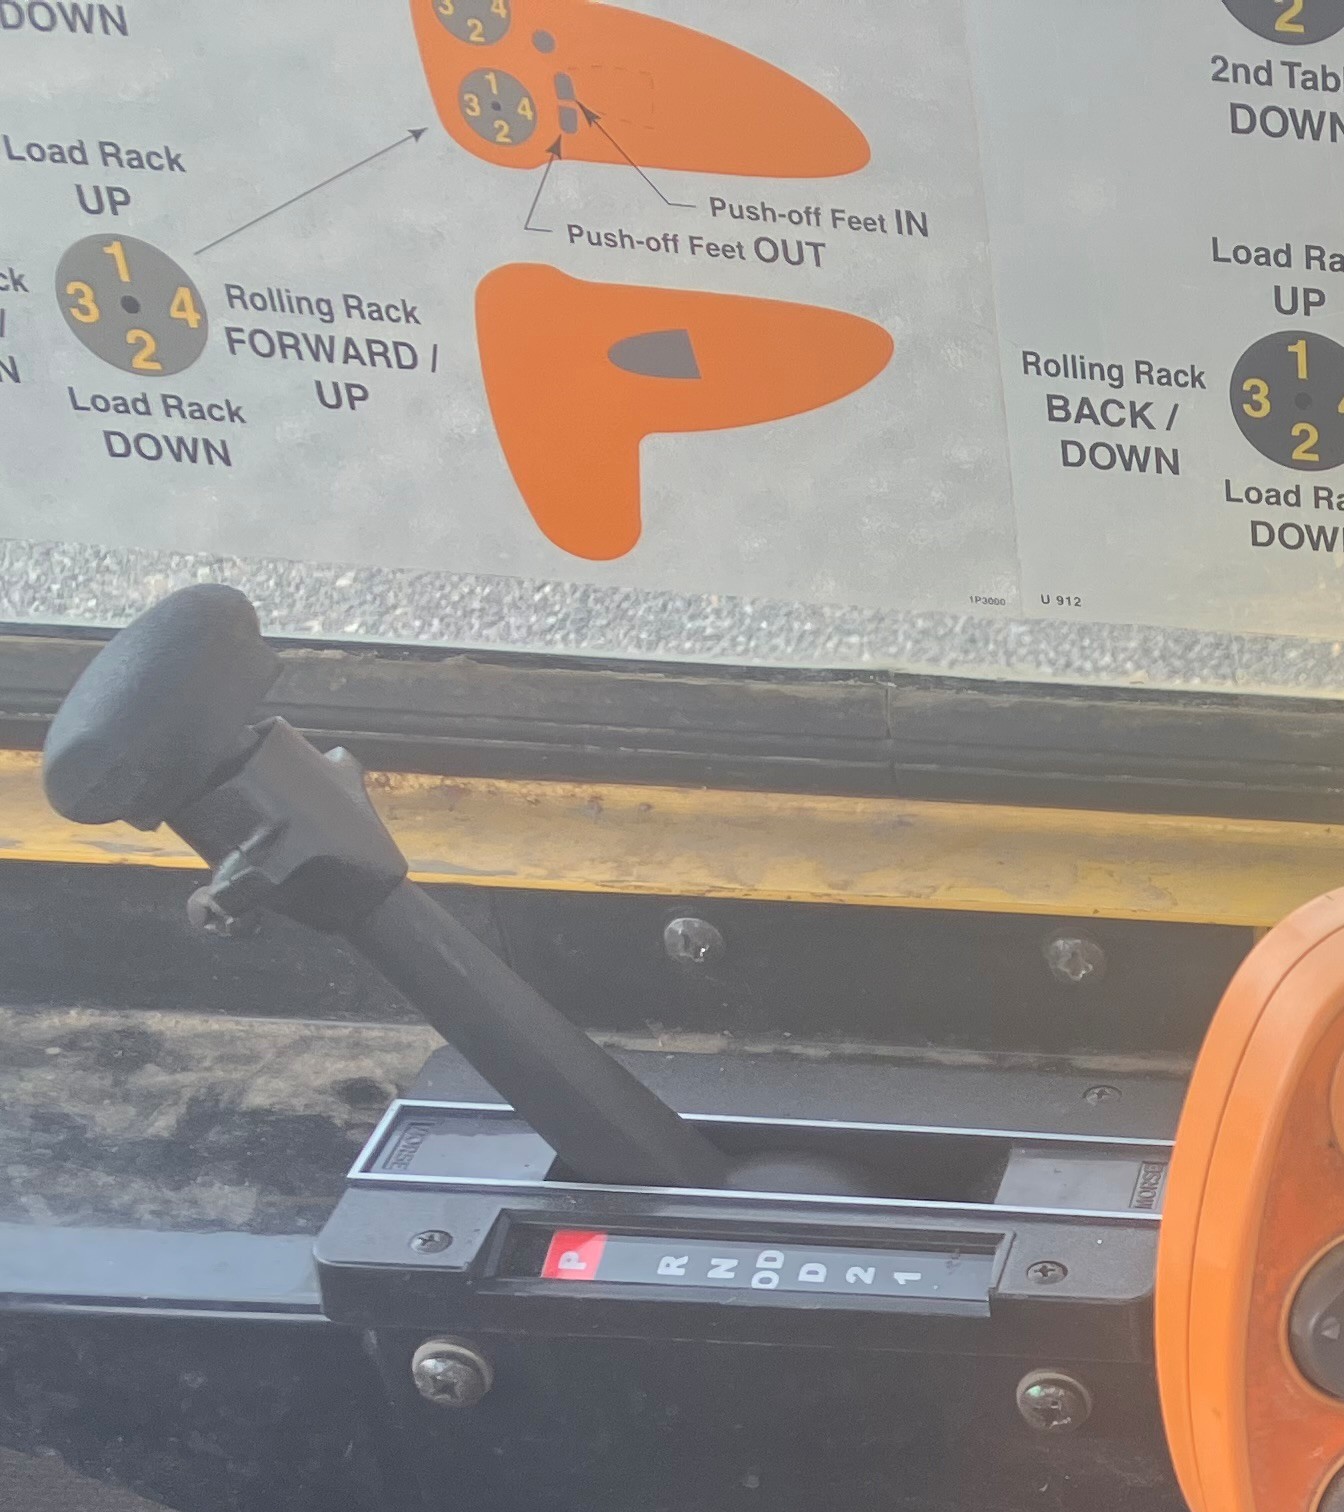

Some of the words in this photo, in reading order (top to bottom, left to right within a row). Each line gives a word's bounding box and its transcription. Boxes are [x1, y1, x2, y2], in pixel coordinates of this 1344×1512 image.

[0, 0, 128, 36] DOWN
[1211, 55, 1272, 86] 2nd
[3, 135, 89, 165] Load
[99, 141, 186, 172] Rack
[75, 184, 130, 216] UP
[710, 197, 821, 227] Push-off
[831, 209, 887, 233] Feet
[895, 209, 928, 237] IN
[104, 242, 129, 282] 1
[567, 224, 678, 253] Push-off
[689, 236, 746, 260] Feet
[754, 237, 825, 267] OUT
[1212, 237, 1291, 268] Load
[67, 282, 99, 322] 3
[169, 286, 201, 328] 4
[225, 284, 334, 323] Rolling
[343, 294, 421, 324] Rack
[1274, 285, 1325, 316] UP
[127, 330, 161, 370] 2
[225, 327, 418, 369] FORWARD
[1288, 340, 1307, 379] 1
[1023, 351, 1123, 389] Rolling
[1135, 360, 1206, 389] Rack
[68, 387, 152, 416] Load
[161, 394, 246, 423] Rack
[315, 380, 368, 410] UP
[1047, 394, 1156, 430] BACK
[1243, 379, 1270, 417] 3
[103, 431, 231, 466] DOWN
[1061, 440, 1179, 475] DOWN
[1292, 423, 1319, 461] 2
[1225, 479, 1301, 507] Load
[1041, 595, 1050, 604] U
[1056, 596, 1081, 607] 912
